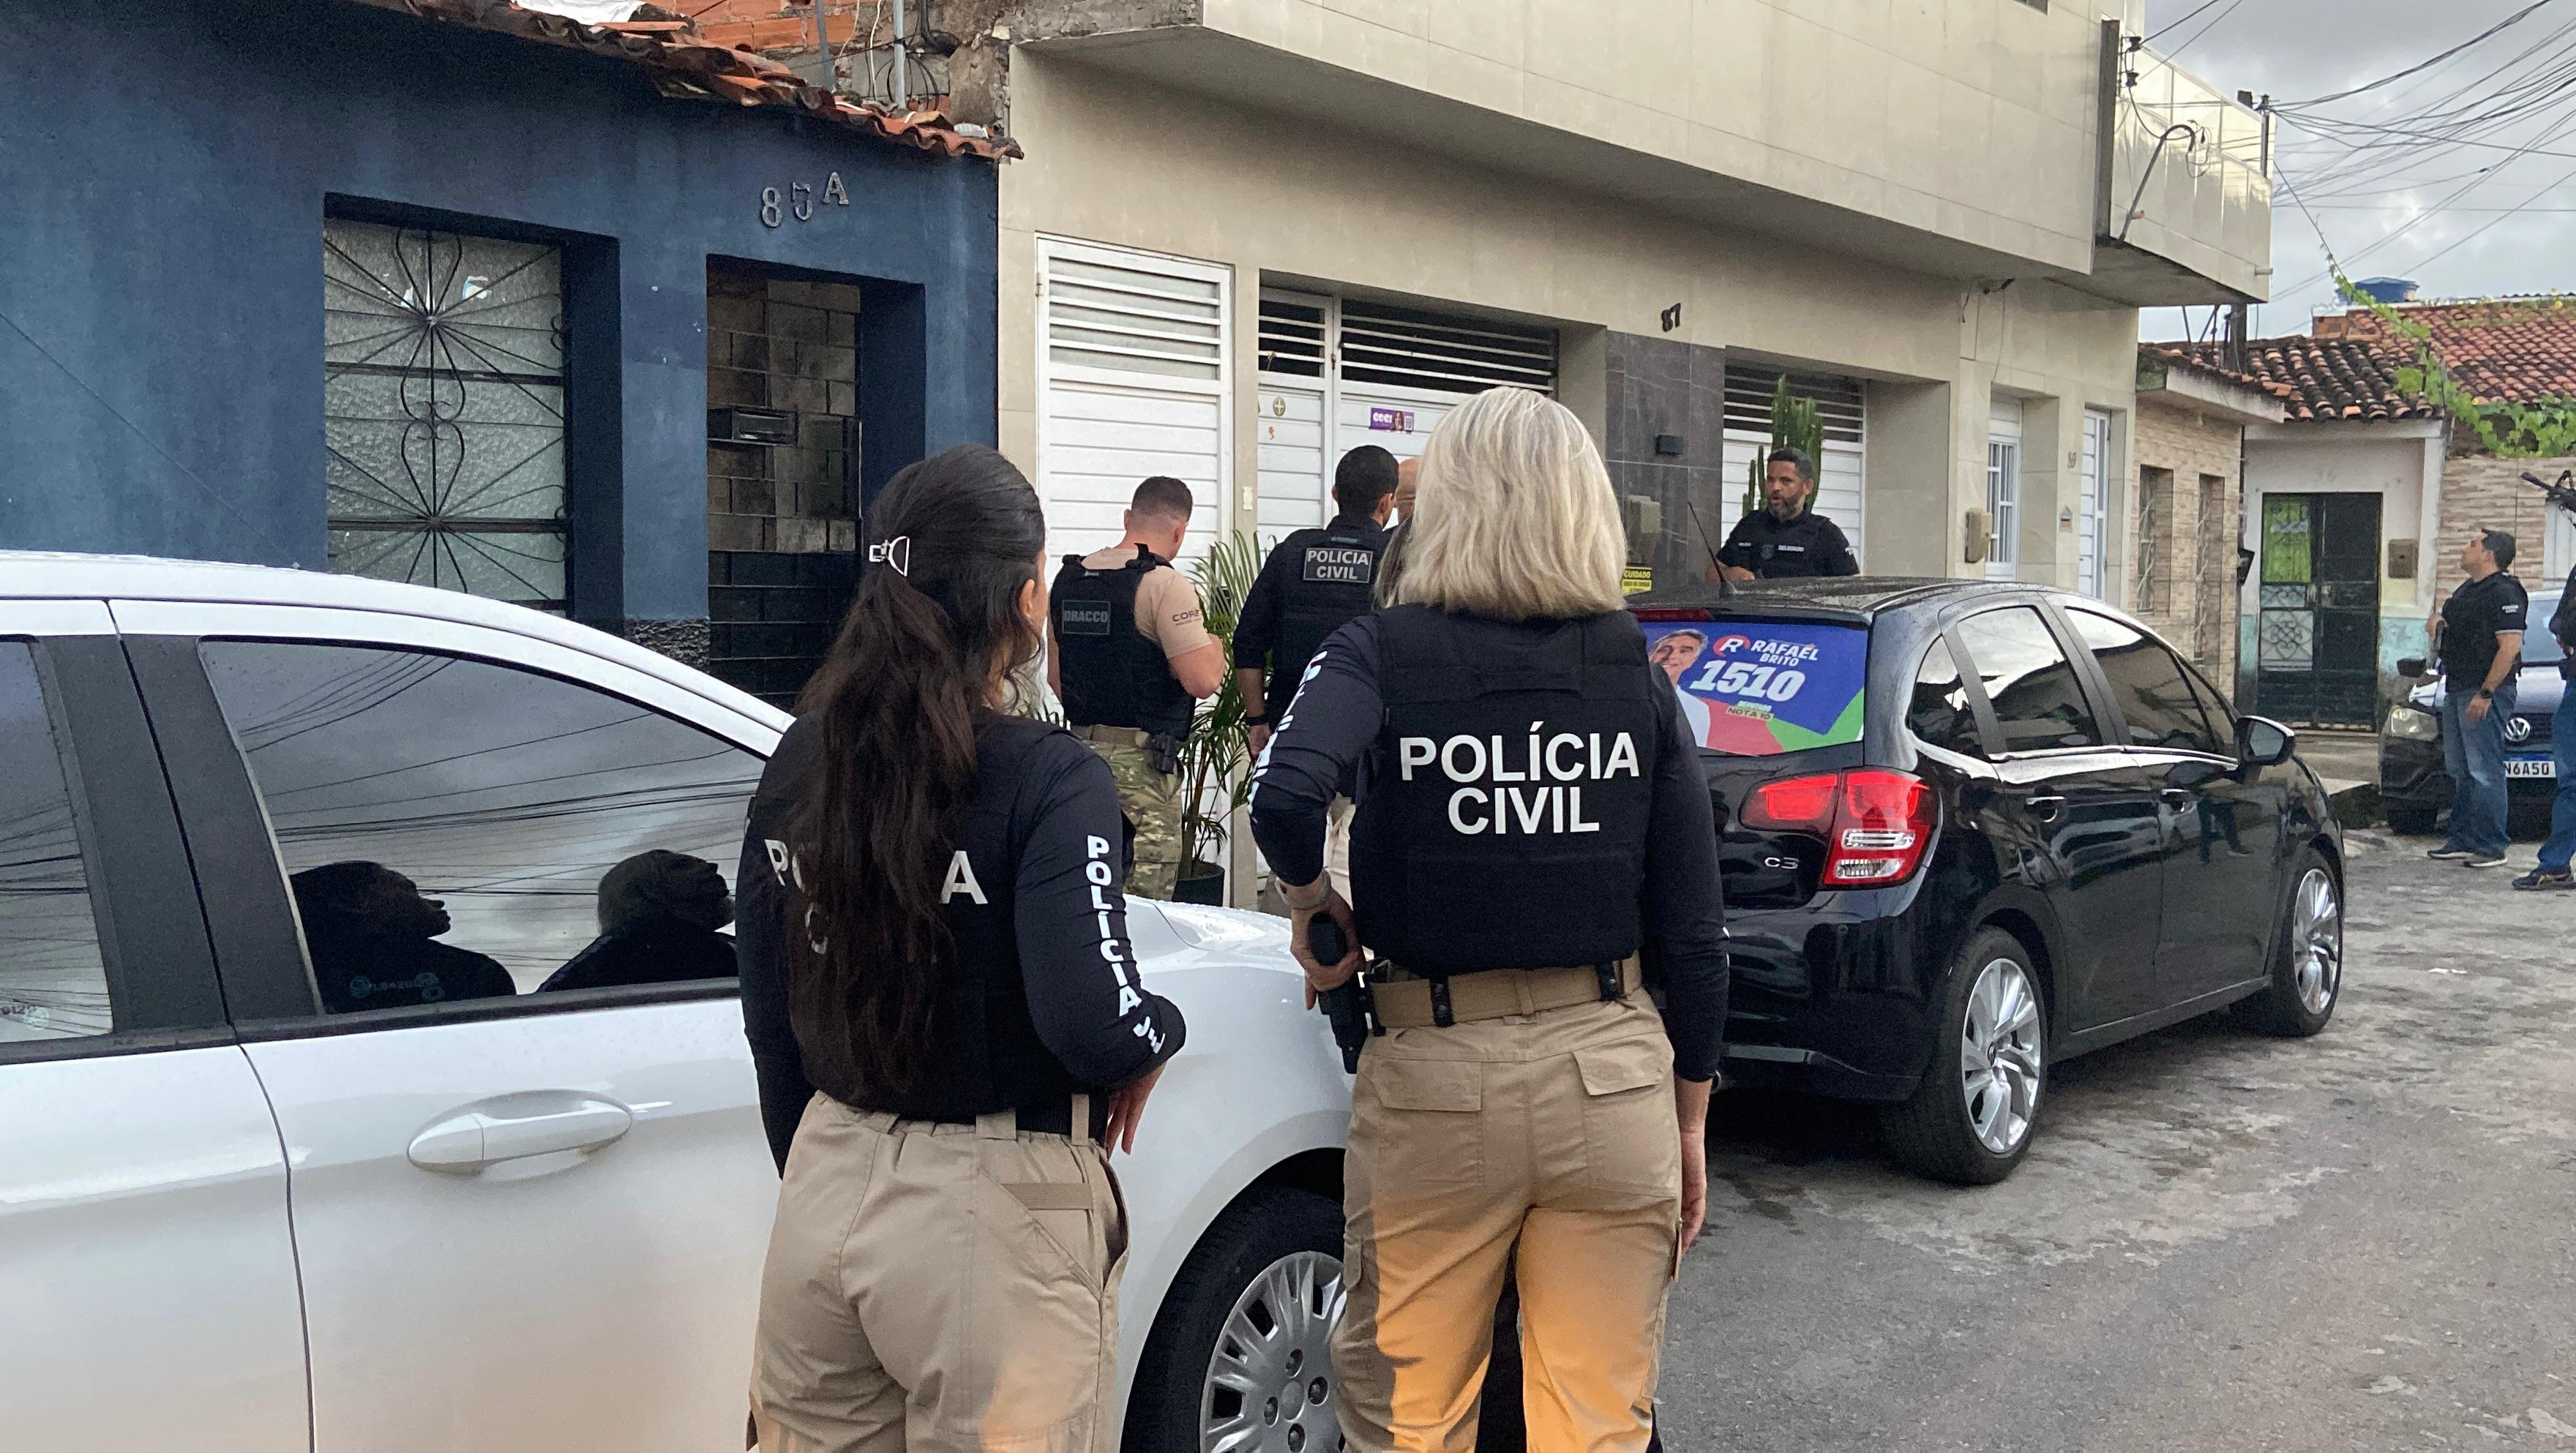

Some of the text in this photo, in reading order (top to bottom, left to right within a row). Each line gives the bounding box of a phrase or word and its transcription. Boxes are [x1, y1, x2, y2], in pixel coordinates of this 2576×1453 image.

[761, 172, 850, 228] 85 A
[1661, 303, 1681, 332] 87
[1307, 550, 1368, 566] POLICIA
[1317, 566, 1358, 580] CIVIL
[1624, 570, 1651, 579] CUIDADO
[1751, 640, 1819, 661] RAFAEL
[1759, 653, 1800, 667] BRITO
[1689, 660, 1806, 702] 1510
[1727, 707, 1757, 718] NOTA
[1399, 721, 1640, 783] POLÍCIA
[1448, 786, 1600, 835] CIVIL
[1764, 857, 1800, 870] C3
[1085, 834, 1142, 1018] POLÍCIA
